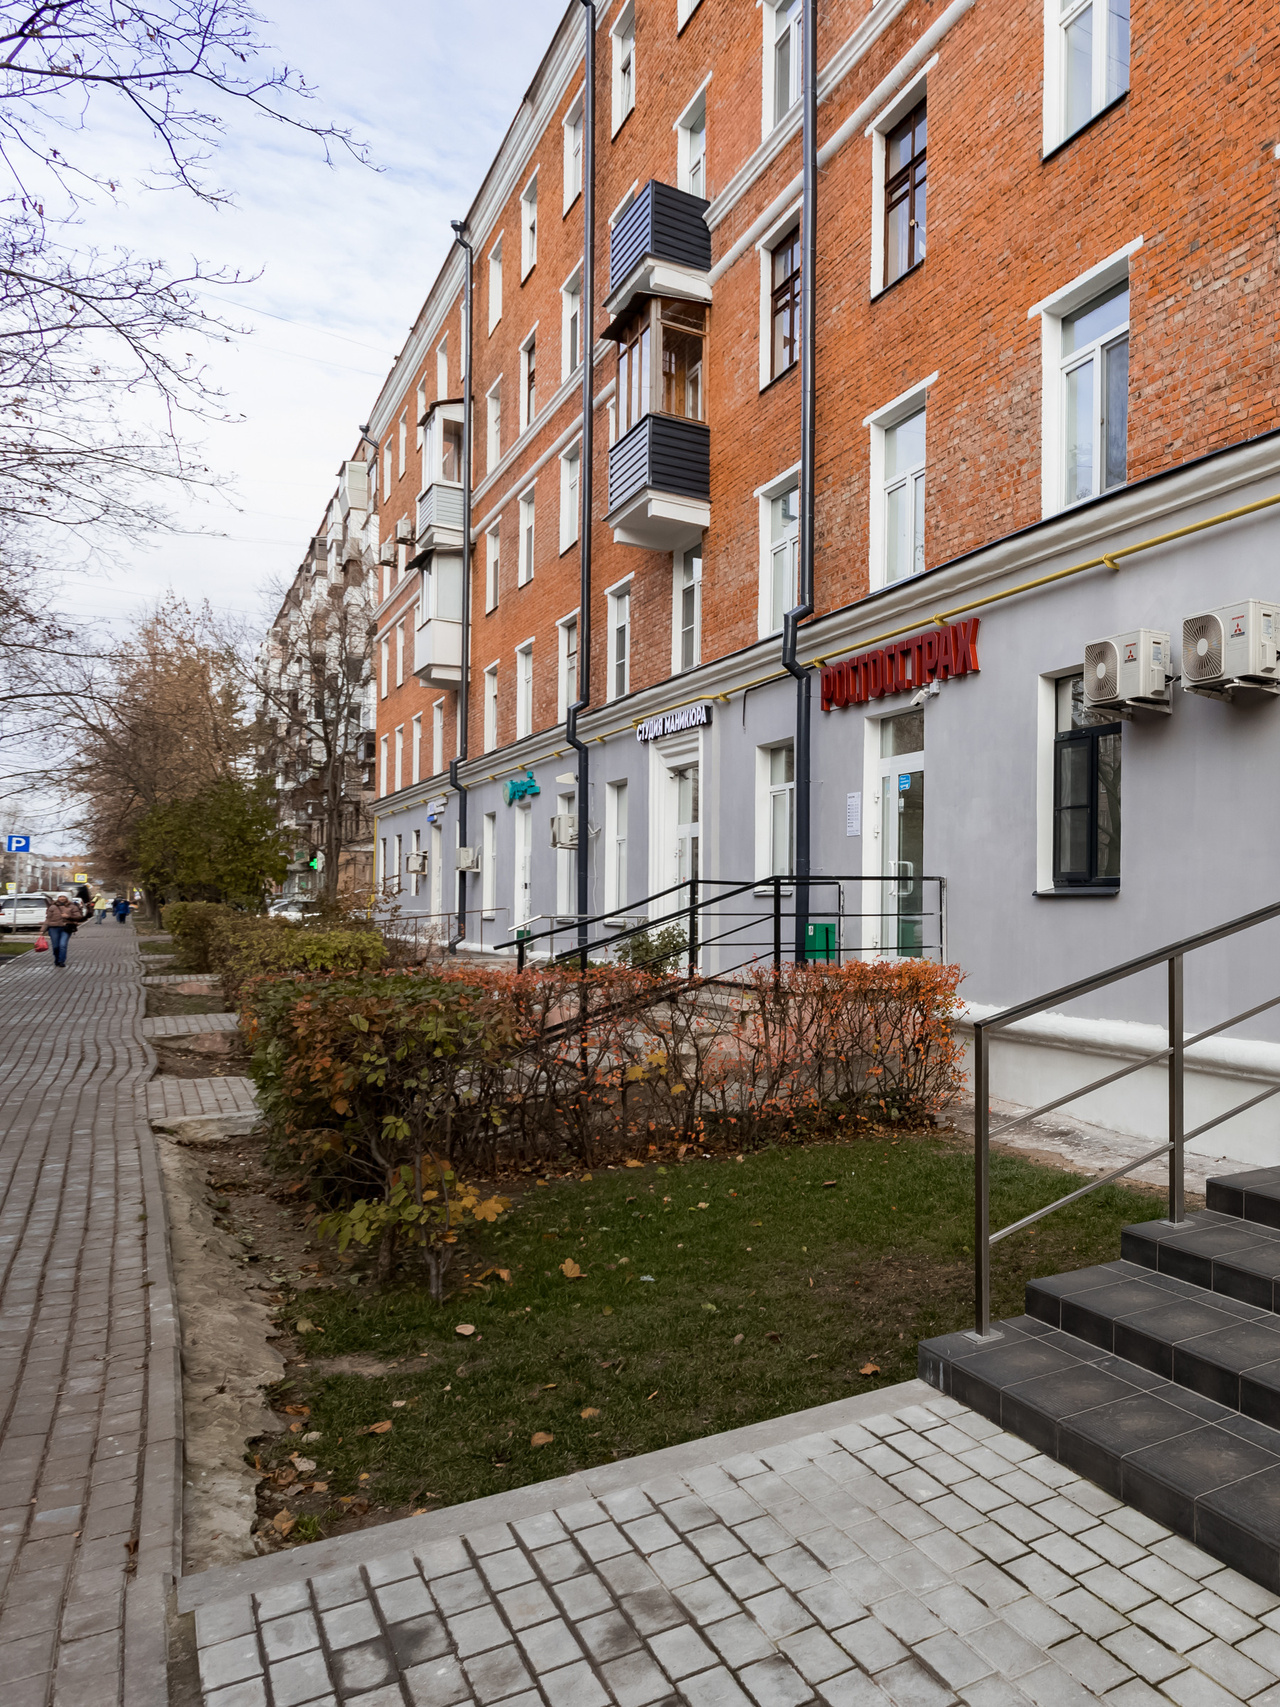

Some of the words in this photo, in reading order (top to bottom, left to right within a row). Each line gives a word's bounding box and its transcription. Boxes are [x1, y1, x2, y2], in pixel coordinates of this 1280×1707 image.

[820, 618, 980, 712] РОСГОССТРАХ
[636, 717, 663, 742] СТУДИЯ
[664, 705, 707, 734] МАНИКЮРА
